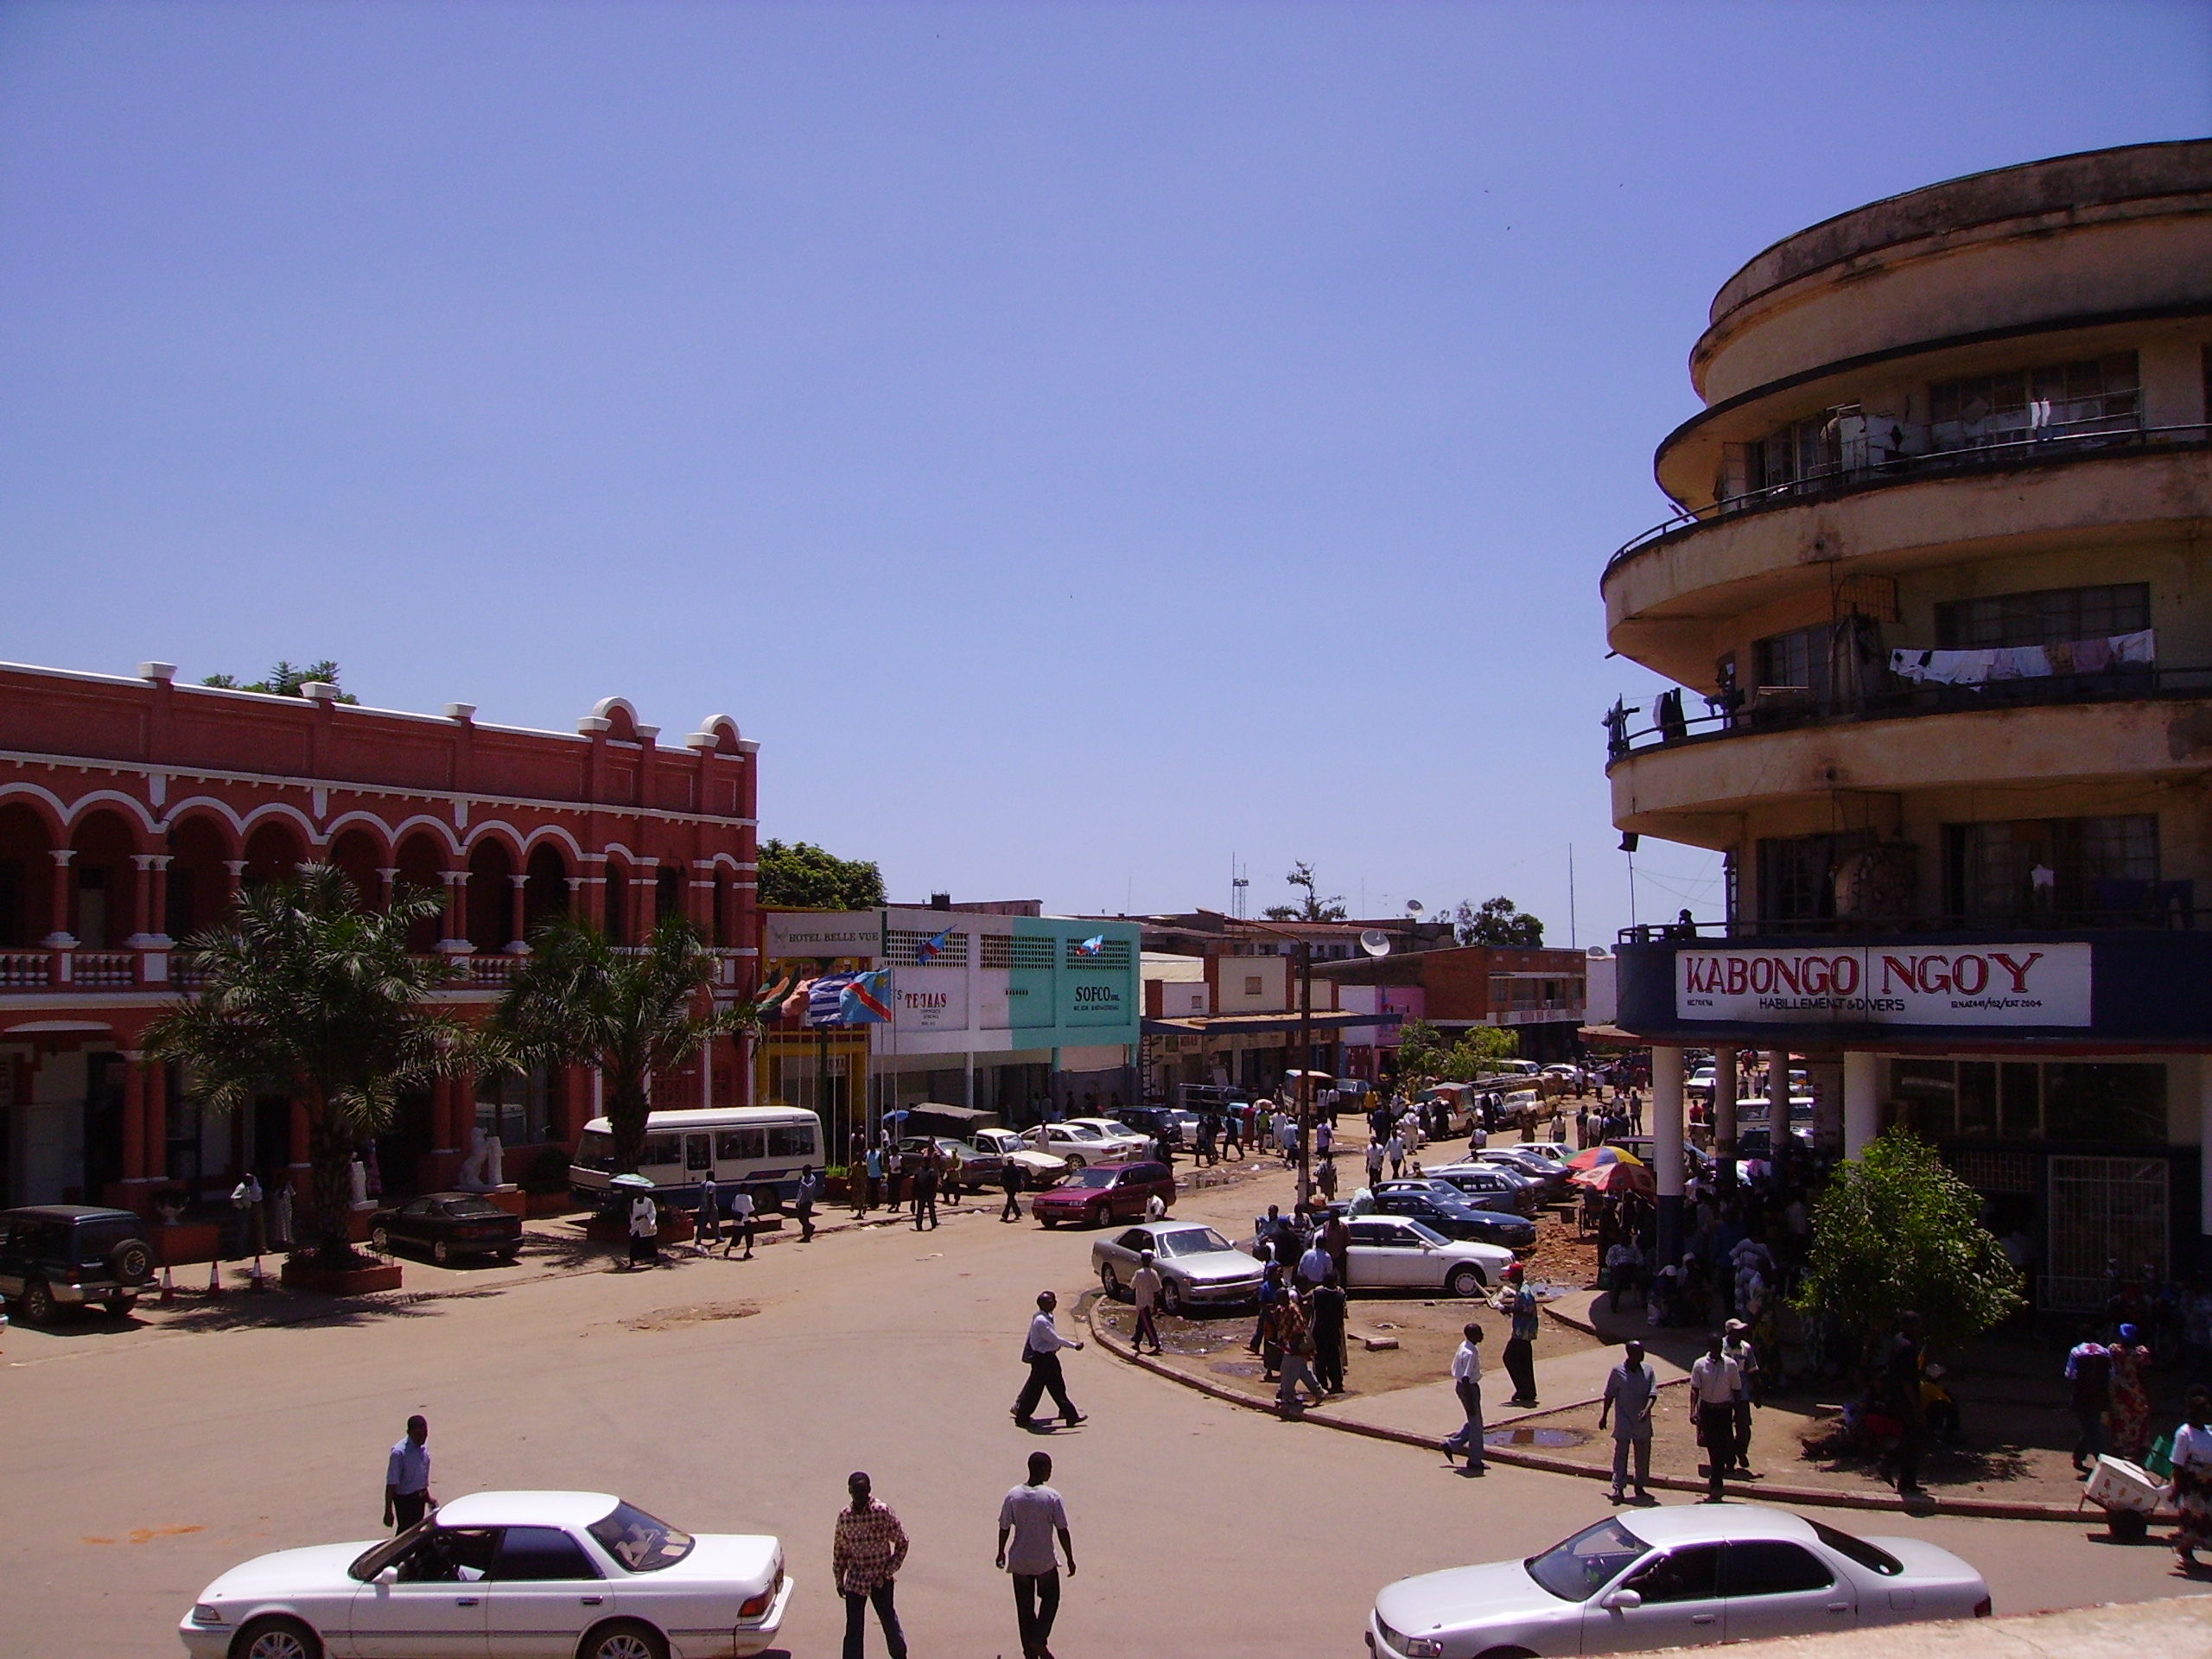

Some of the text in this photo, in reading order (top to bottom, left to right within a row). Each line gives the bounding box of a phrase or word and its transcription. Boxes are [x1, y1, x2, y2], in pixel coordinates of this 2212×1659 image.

[789, 931, 879, 942] HOTEL BELLE VUE
[1686, 951, 2043, 995] KABONGO NGOY
[1075, 986, 1111, 1002] SOFCO
[1857, 998, 1905, 1011] DVERS
